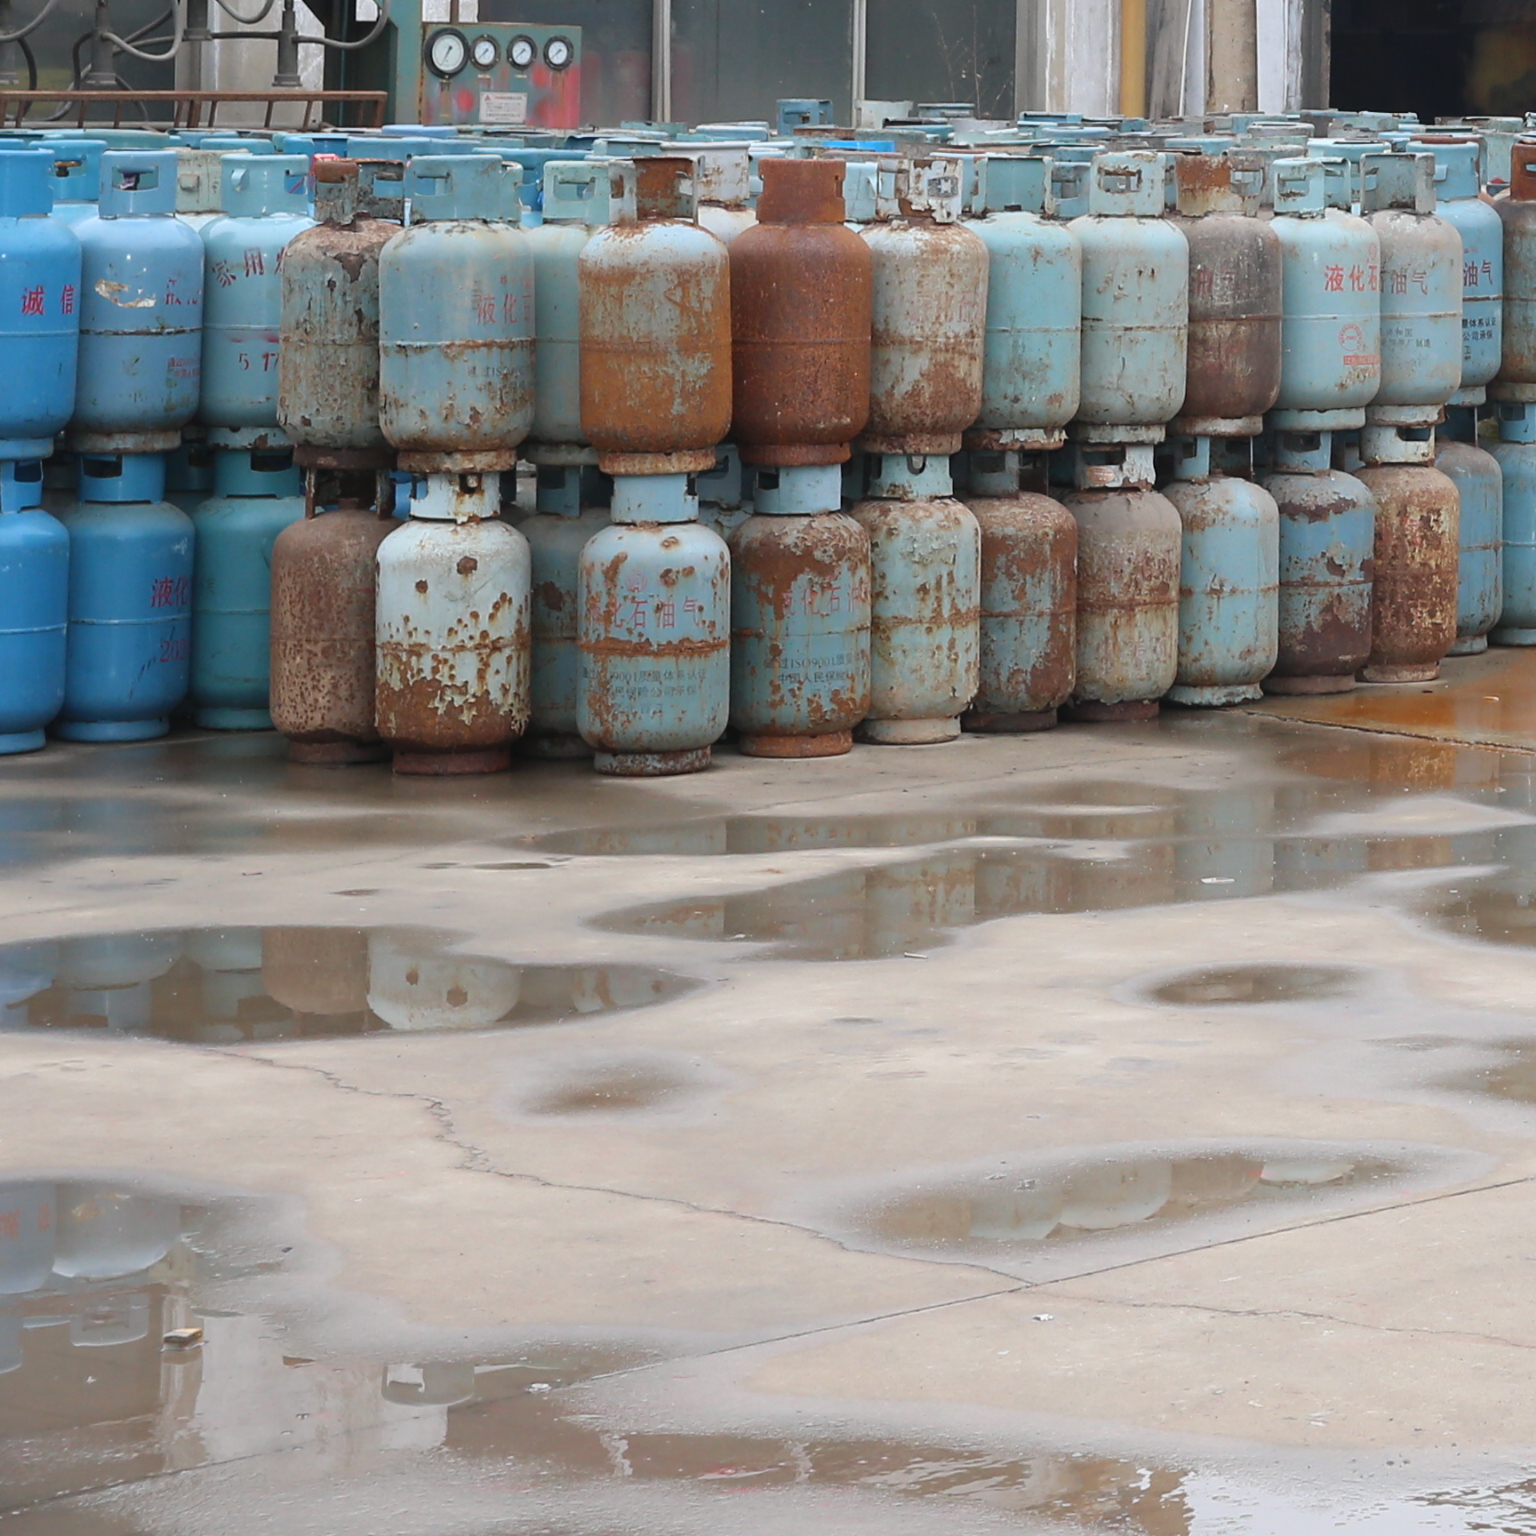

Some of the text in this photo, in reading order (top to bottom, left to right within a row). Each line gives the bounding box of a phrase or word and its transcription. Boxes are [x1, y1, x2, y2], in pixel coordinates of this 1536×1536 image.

[1381, 269, 1428, 295] 油气
[1463, 260, 1493, 287] 油气
[22, 285, 75, 315] 诚信
